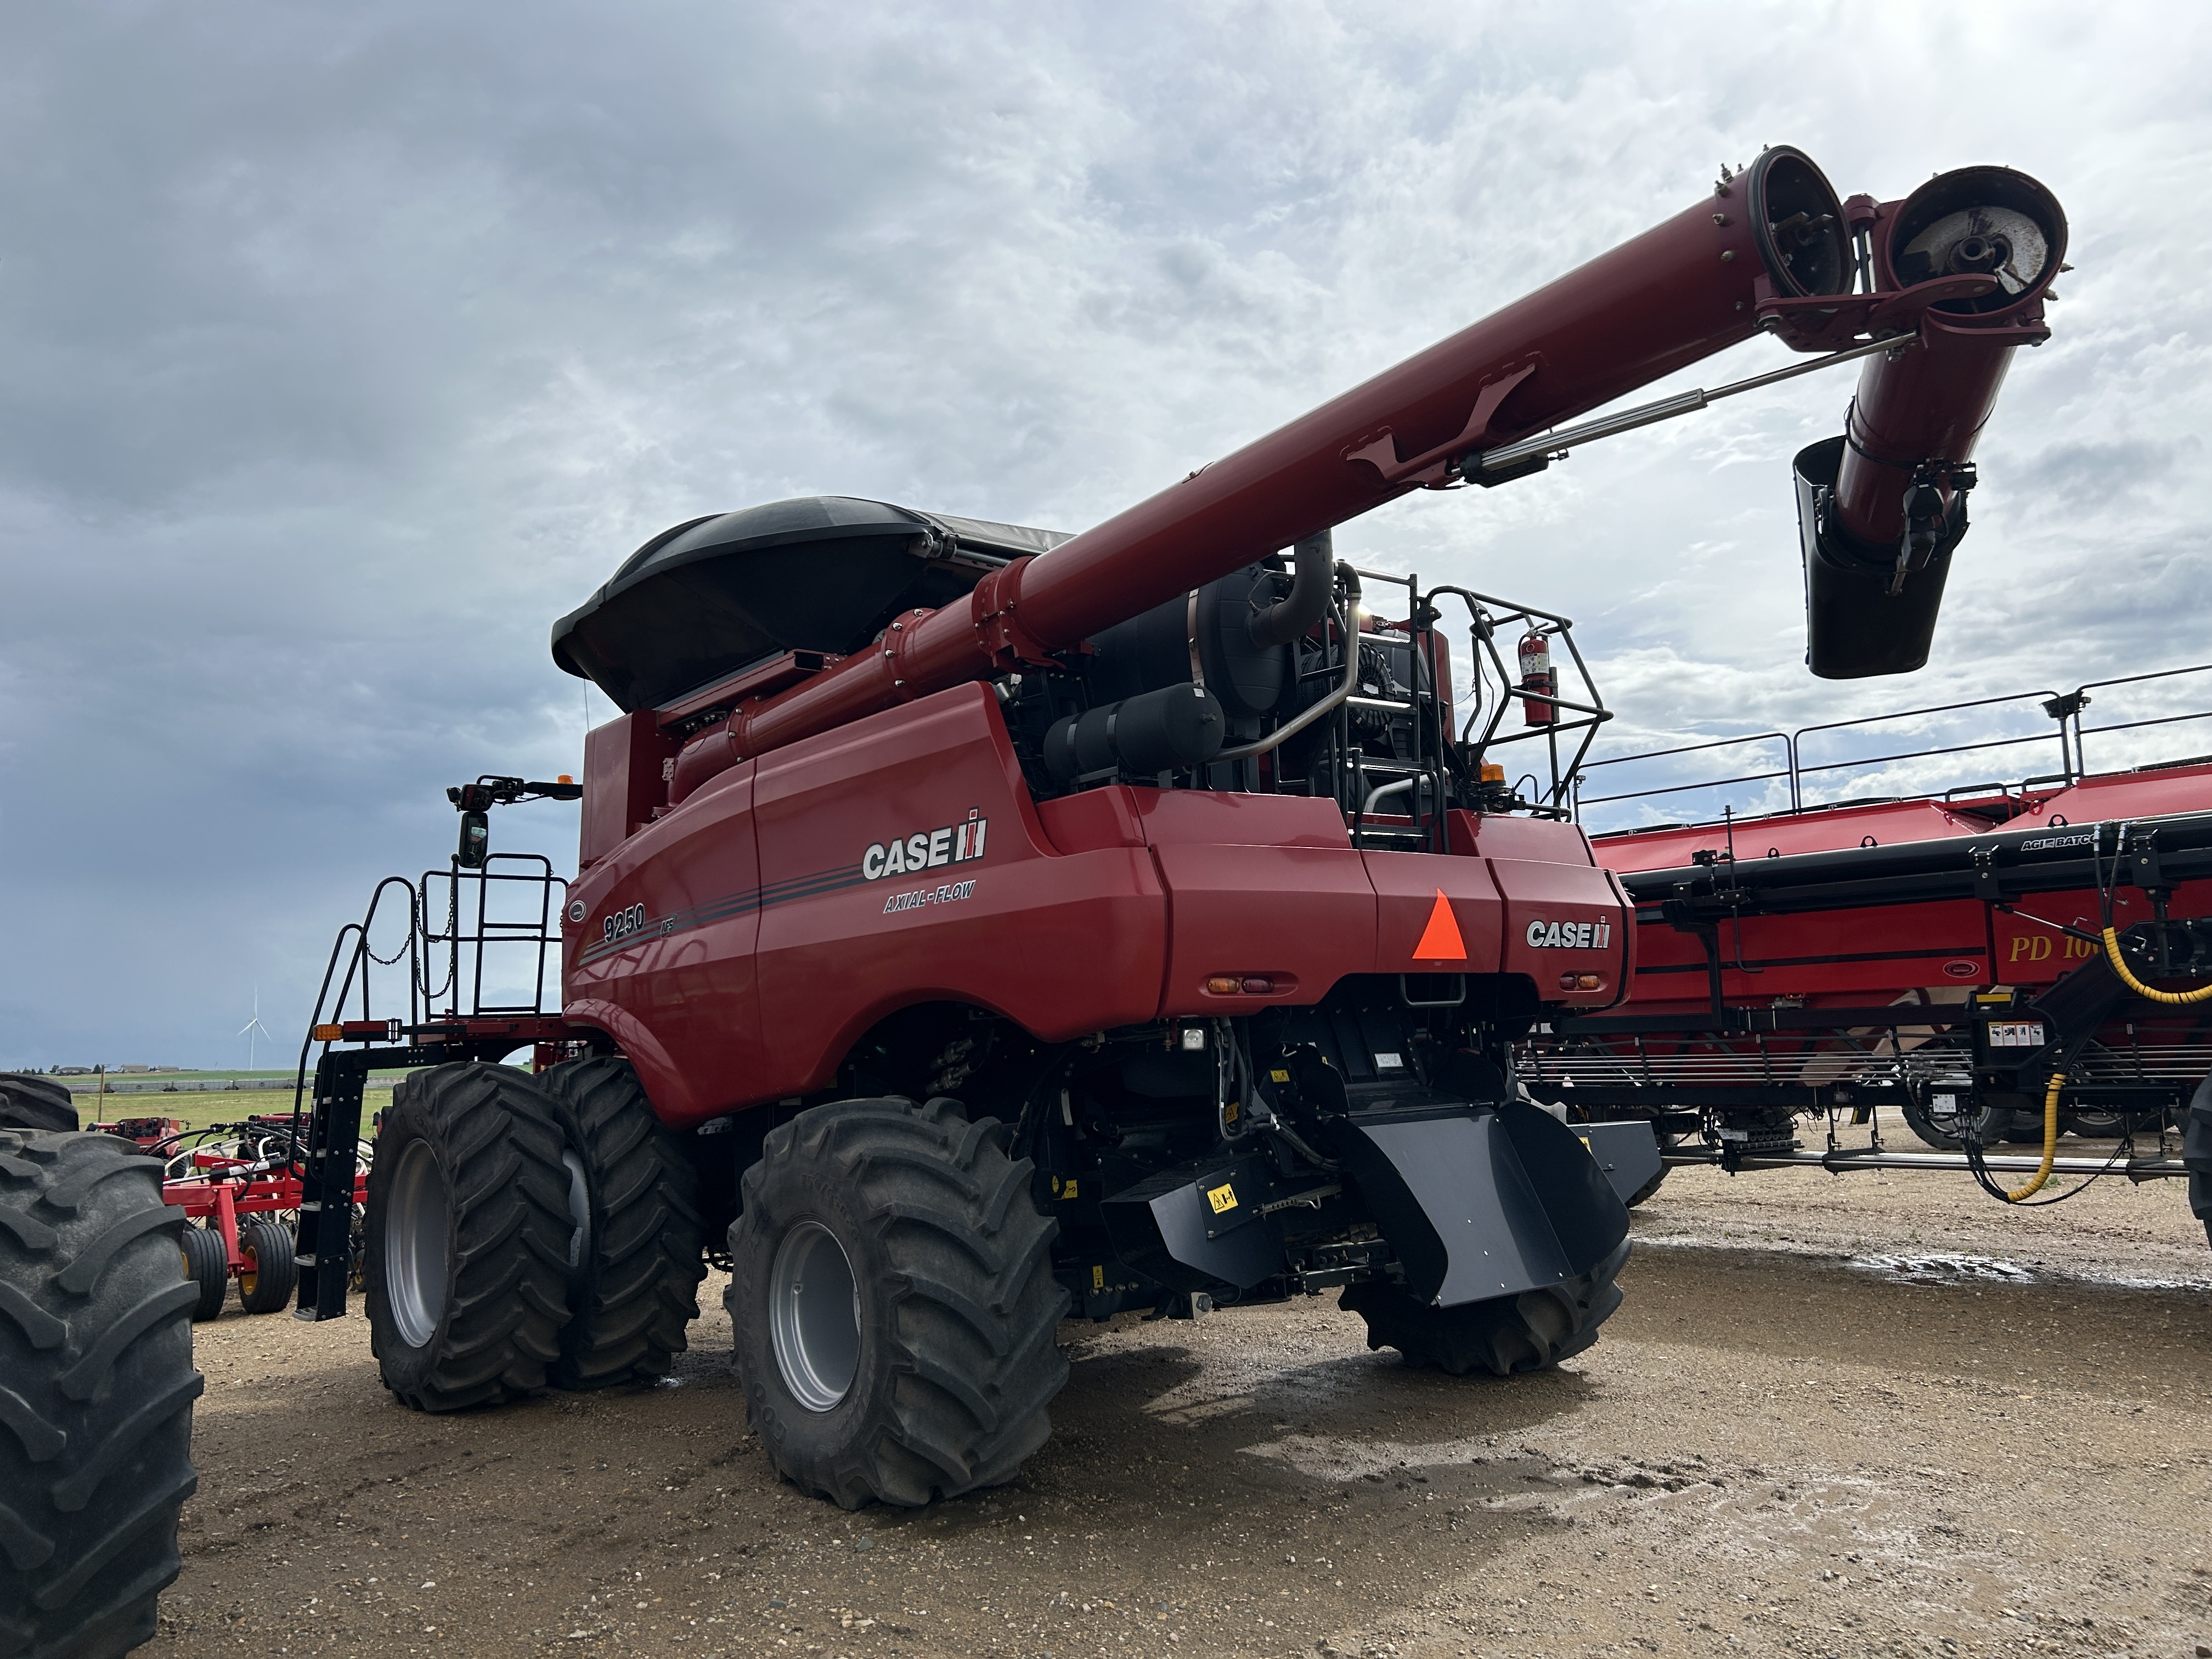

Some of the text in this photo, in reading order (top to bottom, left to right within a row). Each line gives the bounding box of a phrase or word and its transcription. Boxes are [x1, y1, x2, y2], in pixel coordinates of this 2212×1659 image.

[862, 827, 952, 880] CASE
[2021, 839, 2045, 851] AGI
[604, 902, 645, 943] 9250
[1526, 921, 1592, 948] CASE
[2008, 935, 2052, 962] PD
